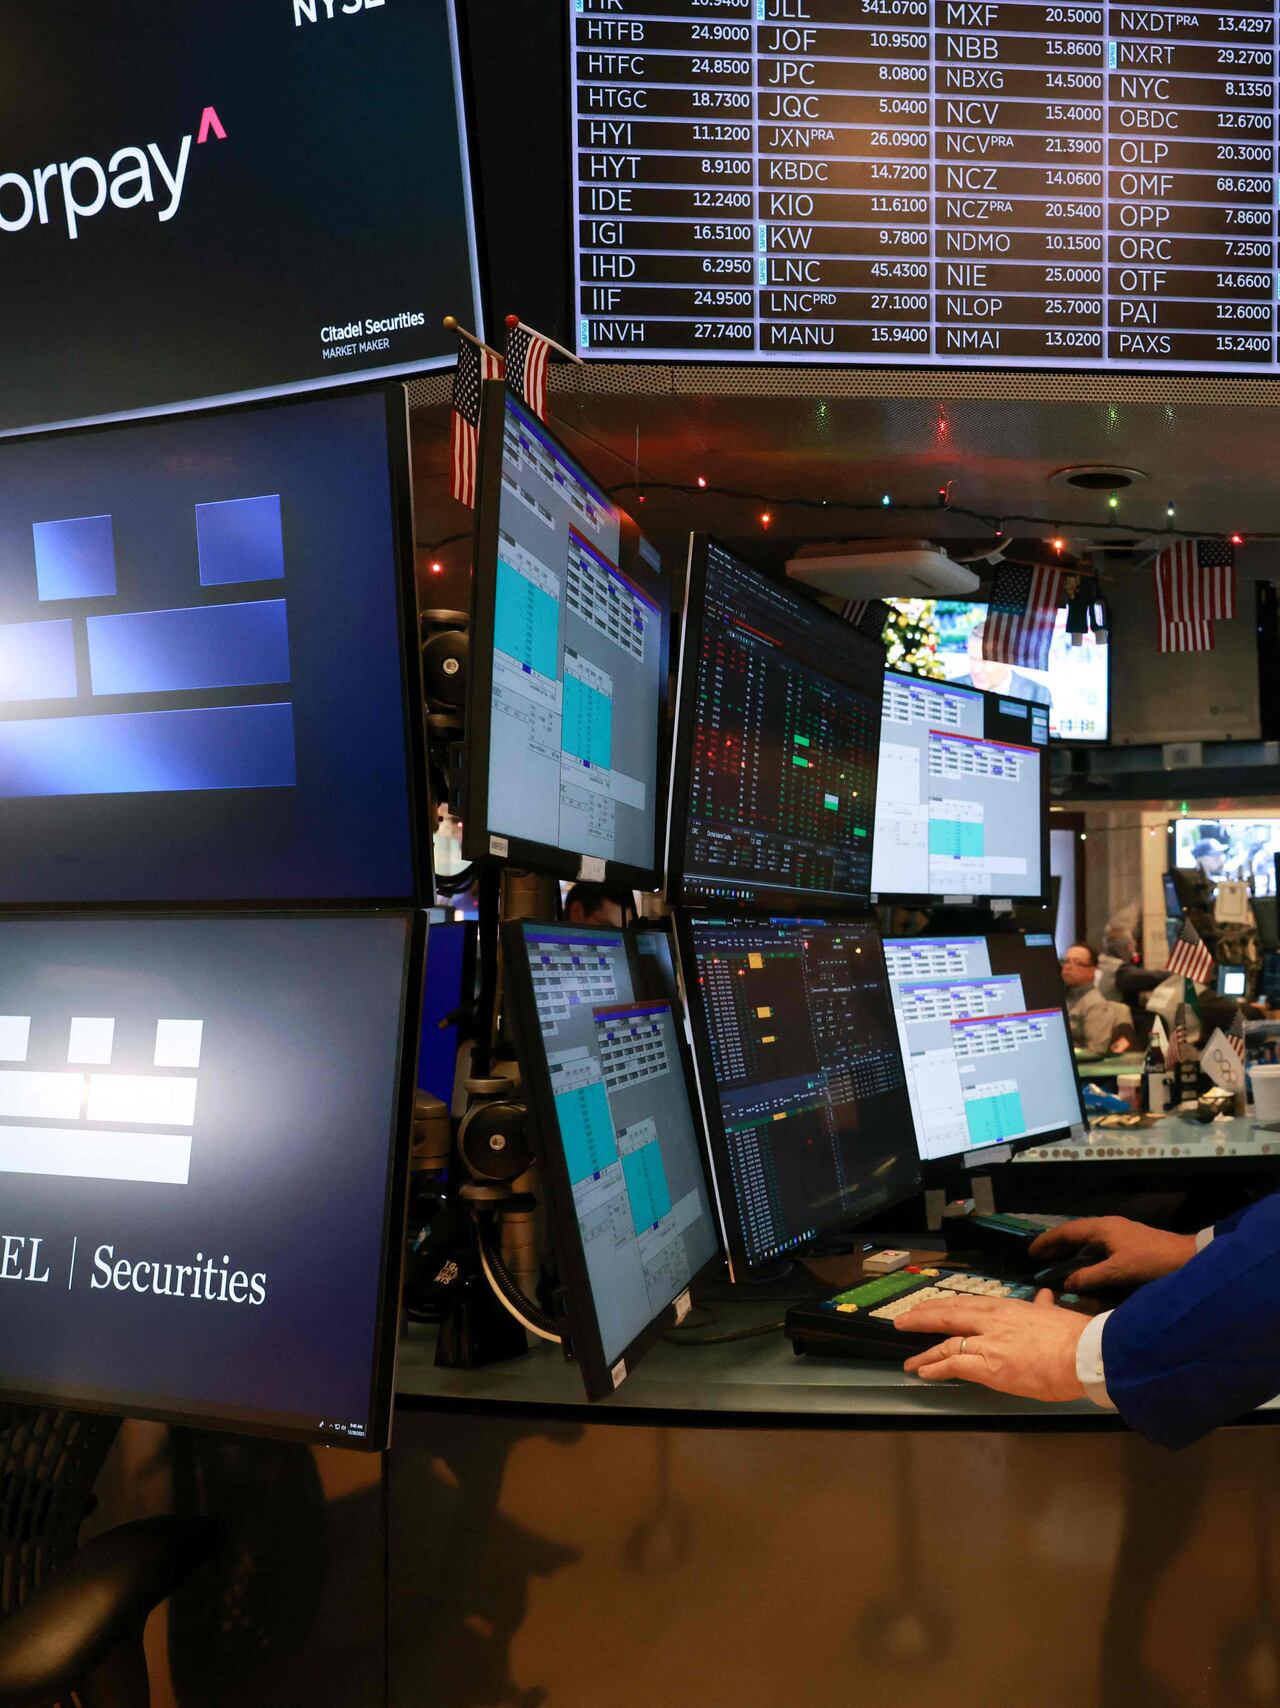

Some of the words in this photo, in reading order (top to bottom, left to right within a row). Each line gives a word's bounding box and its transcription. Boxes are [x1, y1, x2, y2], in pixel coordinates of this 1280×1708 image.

[588, 20, 644, 41] HTFB
[691, 24, 750, 41] 24.9000
[947, 35, 999, 60] NBB
[1045, 40, 1102, 57] 15.8600
[1120, 43, 1176, 65] NXRT
[1217, 49, 1272, 65] 29.2700
[588, 54, 645, 75] HTFC
[691, 58, 750, 75] 24.8500
[589, 88, 647, 109] HTGC
[692, 91, 750, 108] 18.7300
[947, 101, 999, 125] NCV
[1045, 105, 1102, 122] 15.4000
[1119, 108, 1179, 129] OBDC
[1217, 113, 1272, 129] 12.6700
[590, 121, 632, 145] HYI
[692, 125, 751, 141] 11.1200
[591, 155, 641, 179] HYT
[701, 158, 751, 175] 8.9100
[770, 161, 829, 182] KBDC
[870, 164, 928, 180] 14.7200
[1119, 173, 1174, 197] OMF
[1216, 177, 1272, 193] 68.6200
[591, 188, 633, 212] IDE
[693, 191, 751, 208] 12.2400
[770, 193, 814, 217] KIO
[870, 196, 928, 213] 11.6100
[592, 221, 623, 245] IGI
[693, 225, 751, 241] 16.5100
[771, 226, 813, 249] KW
[879, 230, 928, 246] 9.7800
[946, 231, 1011, 252] NDMO
[1045, 235, 1101, 251] 10.1500
[1119, 237, 1172, 260] ORC
[1224, 241, 1271, 257] 7.2500
[592, 255, 636, 278] IHD
[702, 258, 752, 274] 6.2950
[771, 259, 821, 283] LNC
[870, 262, 928, 278] 45.4300
[593, 288, 622, 311] IIF
[694, 290, 752, 306] 24.9500
[320, 320, 363, 343] Citadel
[365, 311, 425, 335] Securities
[593, 322, 644, 342] INVH
[694, 323, 752, 339] 27.7400
[771, 325, 834, 346] MANU
[871, 327, 928, 343] 15.9400
[322, 343, 358, 360] MARKET
[359, 337, 390, 353] MAKER
[1119, 334, 1171, 354] PAXS
[1216, 336, 1271, 352] 15.2400
[0, 1235, 50, 1283] EL
[90, 1244, 267, 1306] Securities
